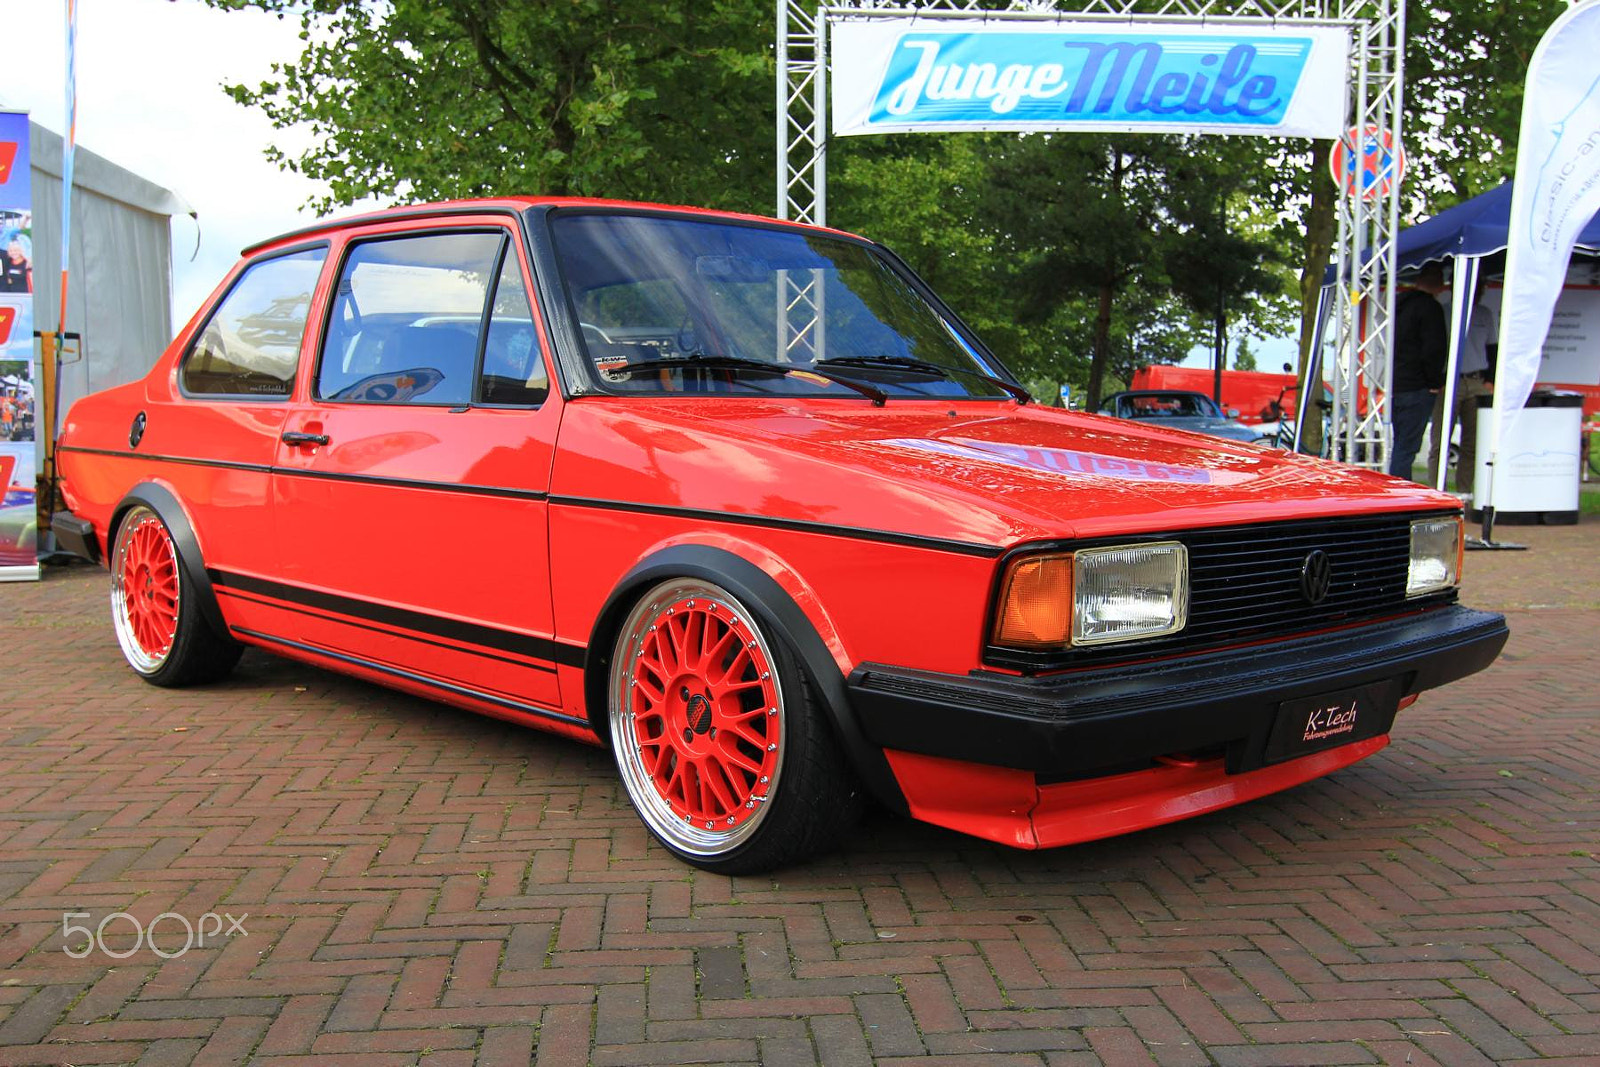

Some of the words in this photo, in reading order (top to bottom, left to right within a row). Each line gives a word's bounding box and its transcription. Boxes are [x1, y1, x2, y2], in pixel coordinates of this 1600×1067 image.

[887, 41, 1066, 115] Junge
[1065, 43, 1280, 117] Meile
[1306, 701, 1357, 731] K-Tech
